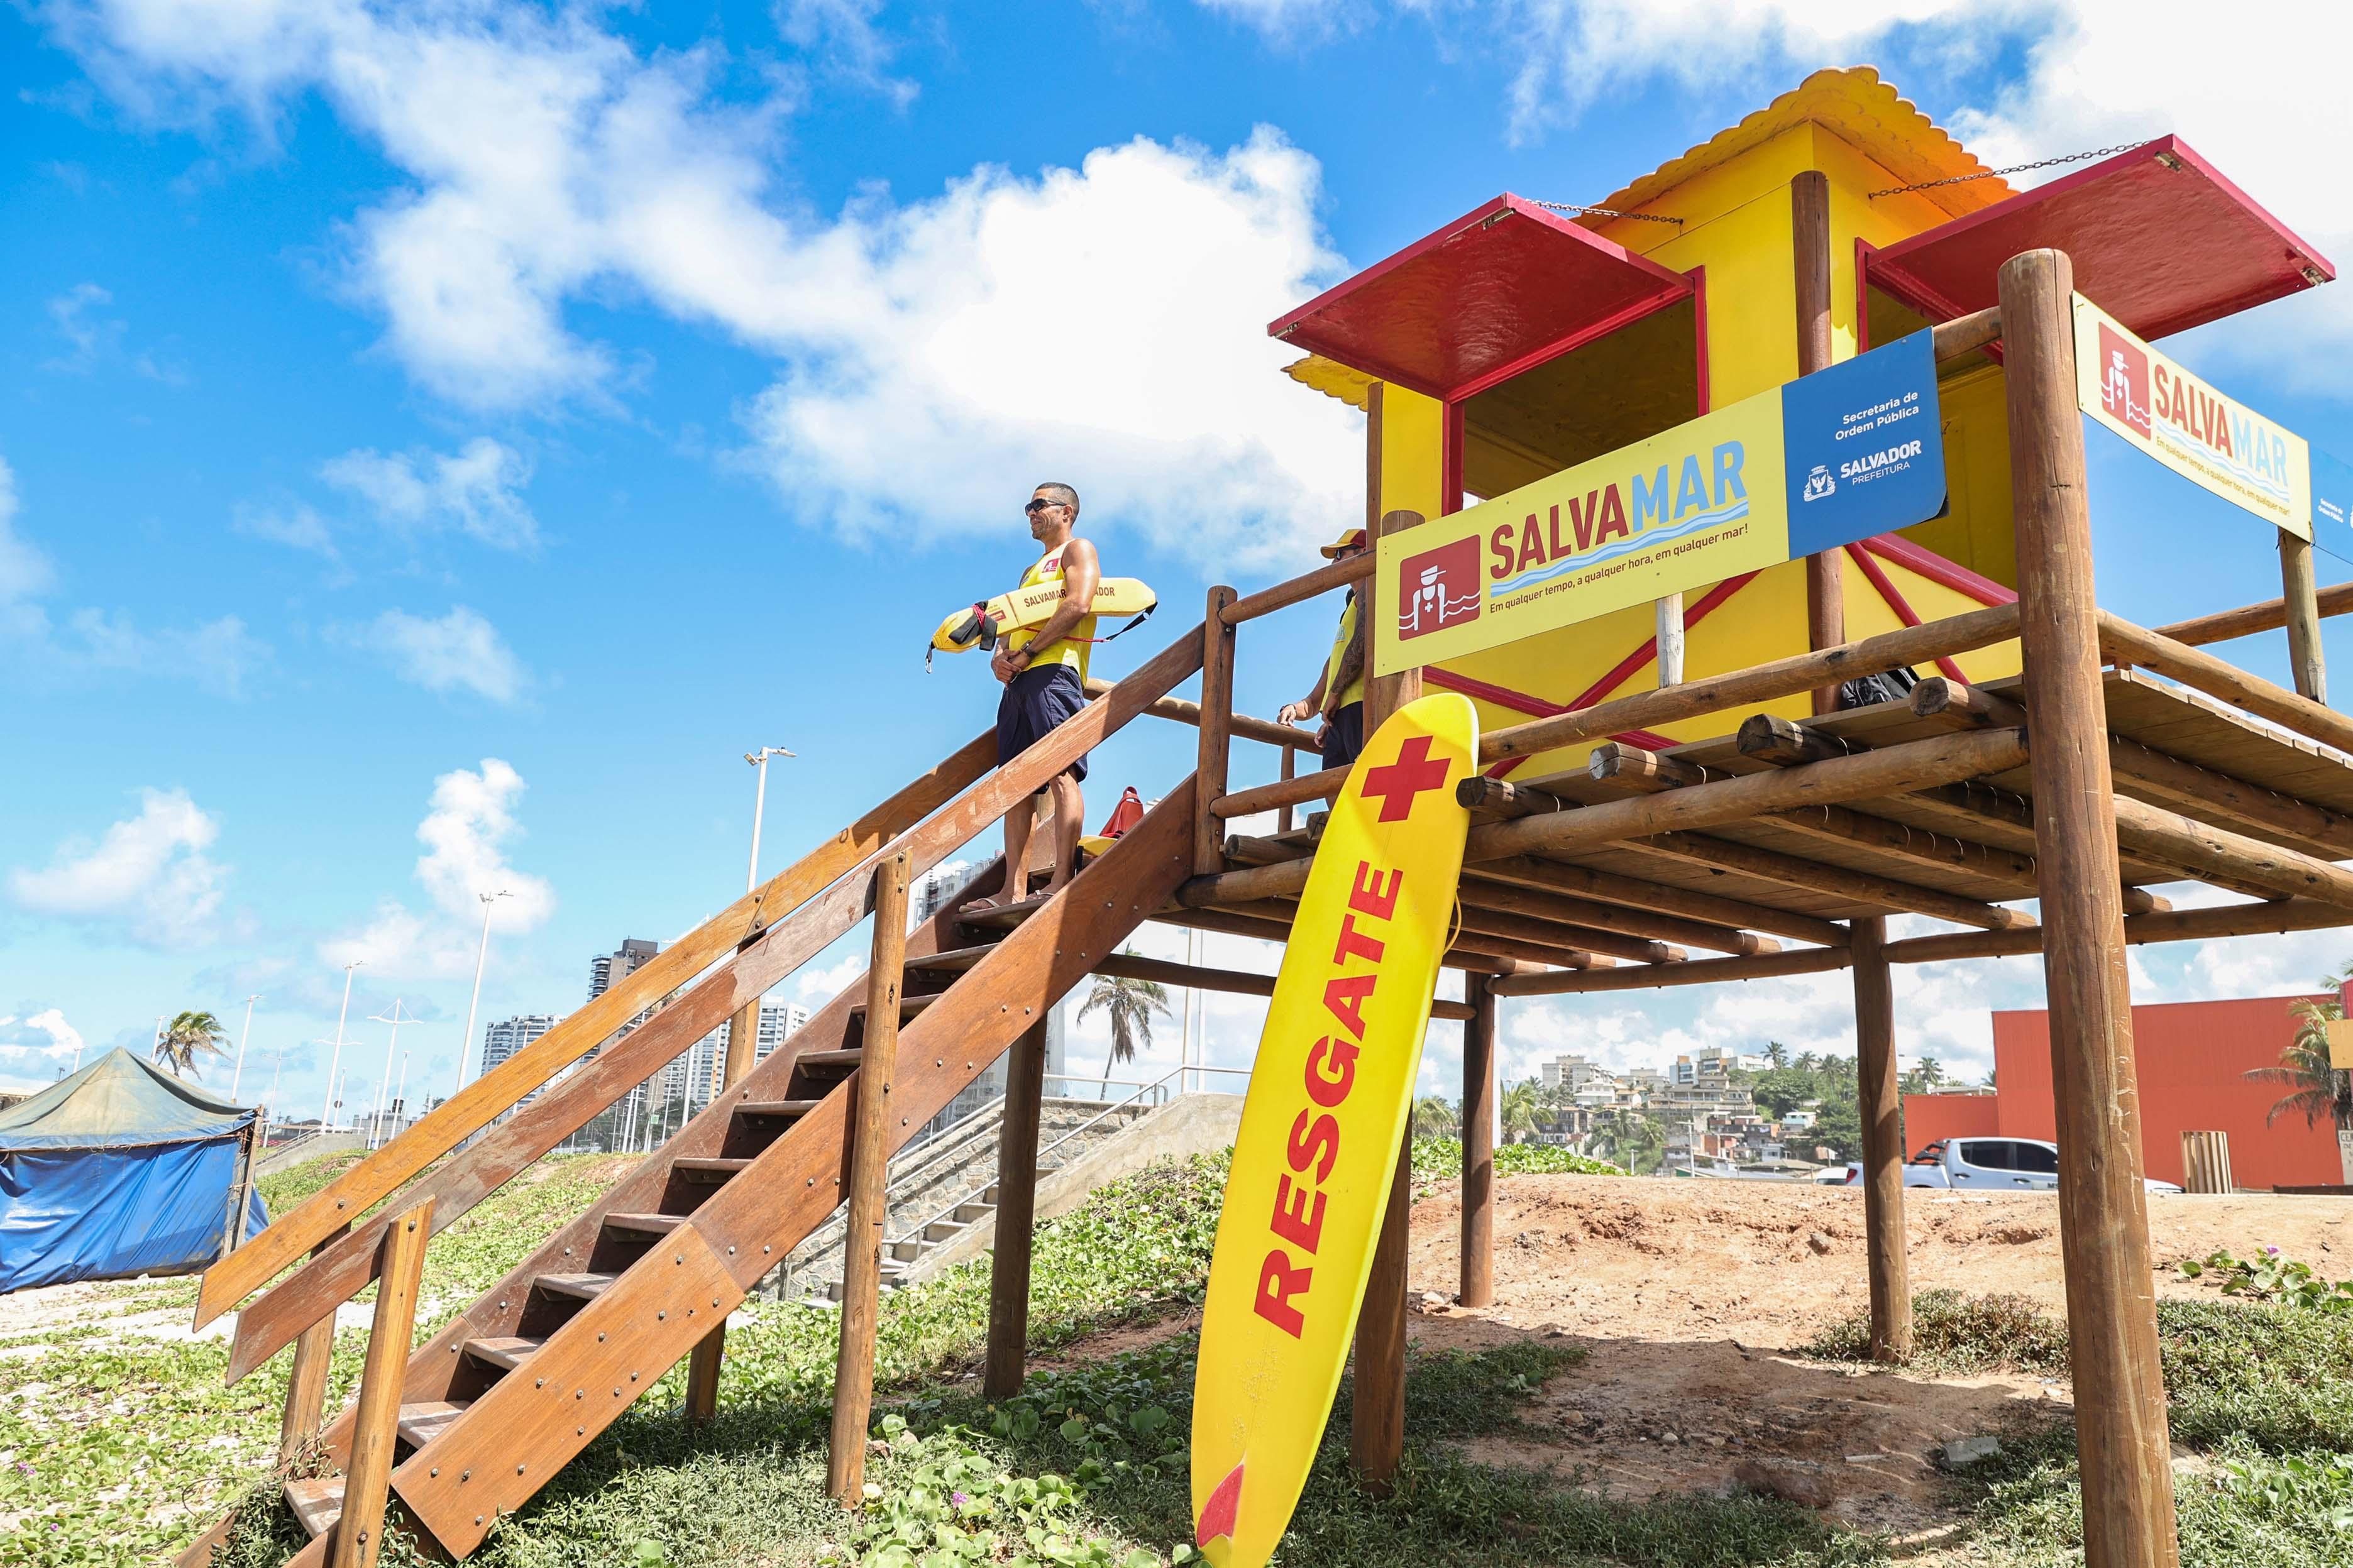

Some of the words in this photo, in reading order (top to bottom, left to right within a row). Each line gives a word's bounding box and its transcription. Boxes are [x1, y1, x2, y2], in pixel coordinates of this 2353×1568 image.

[1835, 422, 1874, 441] Ordem
[1877, 406, 1920, 427] Pública
[1843, 398, 1900, 425] Secretaria
[1903, 392, 1919, 403] de
[2154, 364, 2288, 486] SALVAMAR
[1840, 440, 1922, 478] SALVADOR
[1852, 461, 1910, 485] PREFEITURA
[1491, 441, 1747, 579] SALVAMAR
[1490, 603, 1504, 613] Em
[1505, 589, 1543, 610] qualquer
[1545, 580, 1575, 596] tempo,
[1577, 577, 1582, 585] a
[1584, 563, 1626, 583] qualquer
[1629, 556, 1653, 569] hora,
[1655, 549, 1671, 561] em
[1673, 534, 1719, 556] qualquer
[1722, 523, 1748, 540] mar!
[1024, 588, 1067, 608] SALVAMAR
[1254, 860, 1404, 1340] RESGATE
